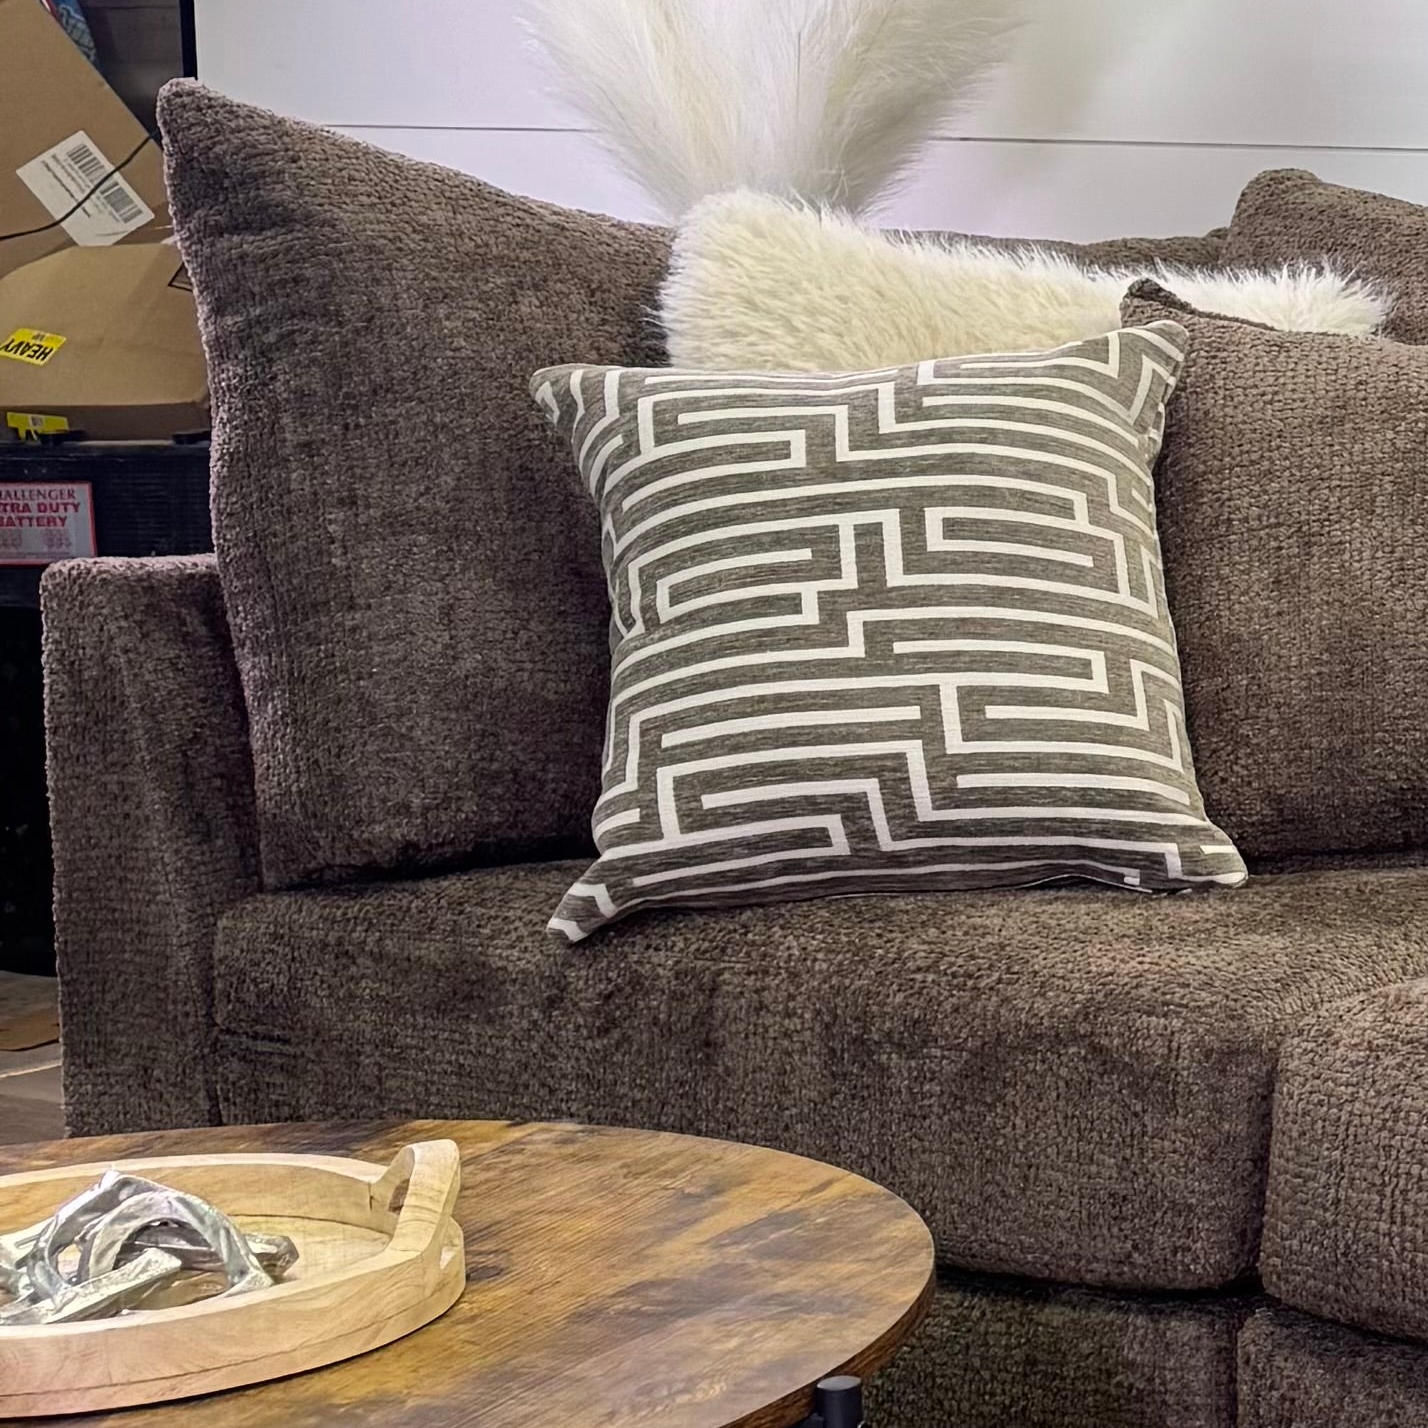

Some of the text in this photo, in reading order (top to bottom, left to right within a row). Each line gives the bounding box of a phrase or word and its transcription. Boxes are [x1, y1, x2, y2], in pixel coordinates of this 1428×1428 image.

[1, 338, 54, 362] HEAVY
[0, 502, 80, 513] TRA DUTY
